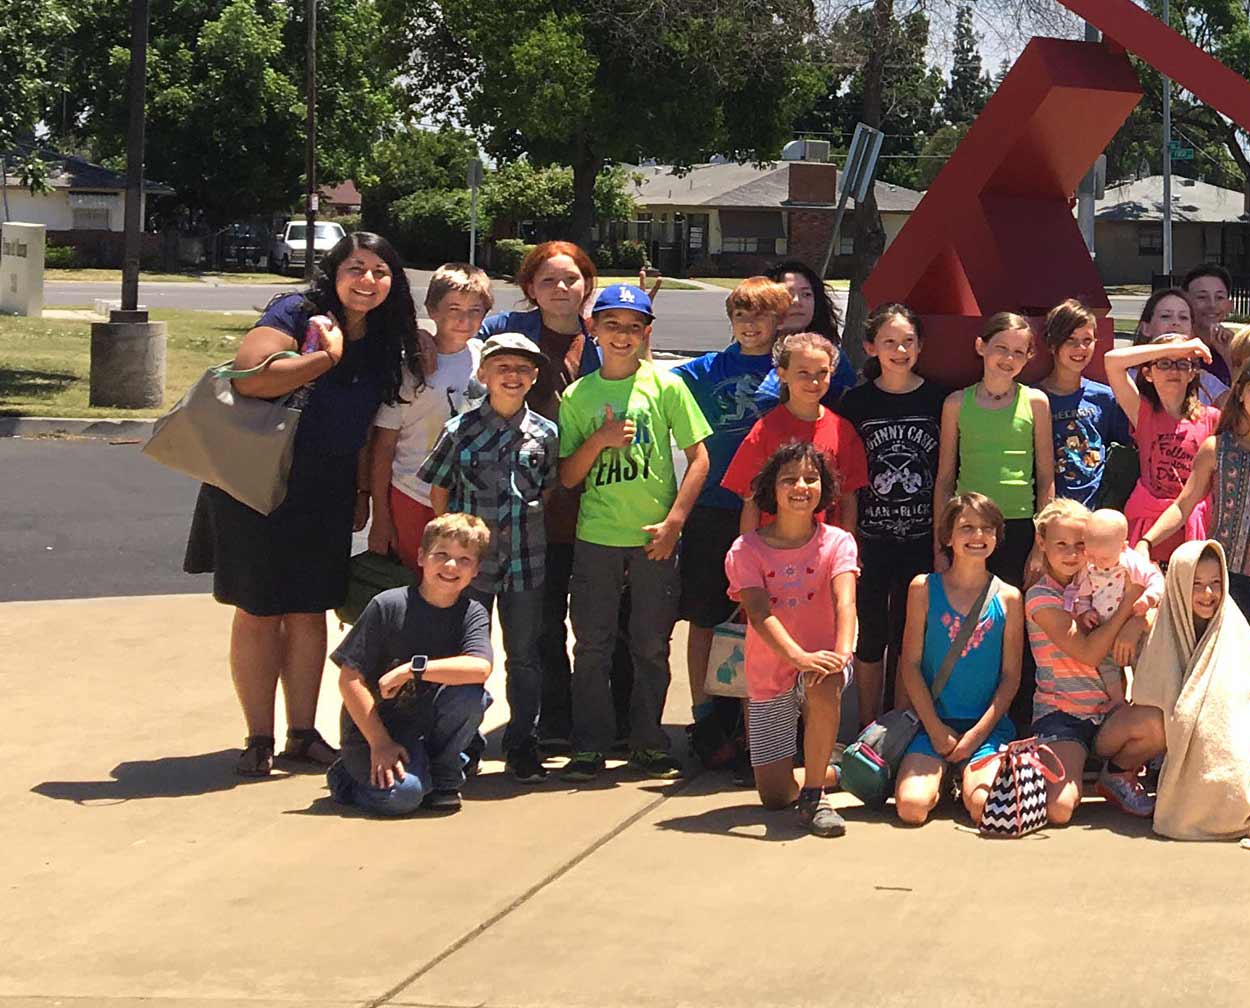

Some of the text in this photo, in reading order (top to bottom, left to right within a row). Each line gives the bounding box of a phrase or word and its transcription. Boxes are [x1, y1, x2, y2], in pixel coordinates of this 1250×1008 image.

[618, 286, 635, 303] LA
[907, 426, 938, 453] CASH
[595, 441, 656, 486] EASY
